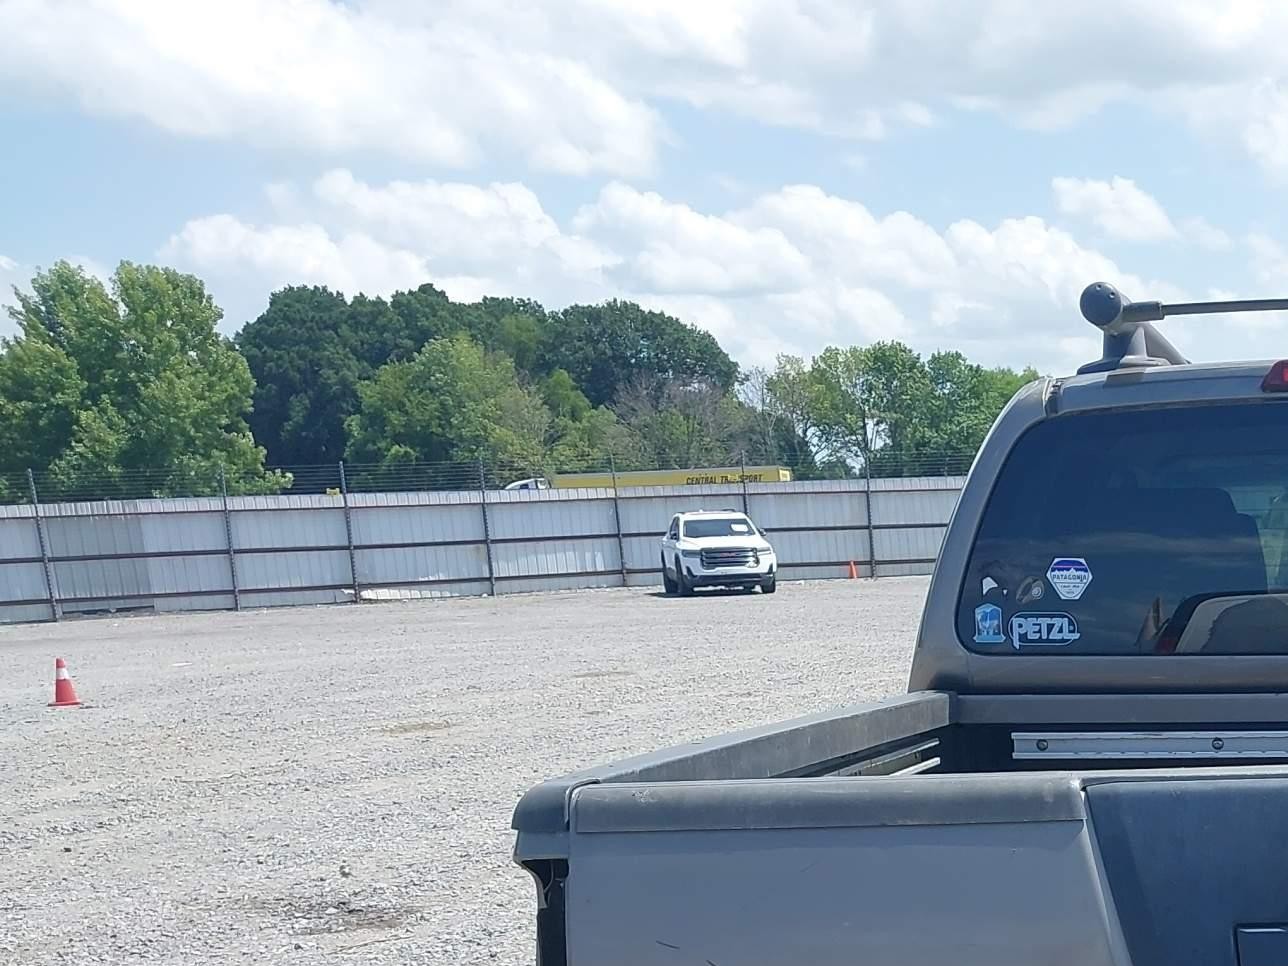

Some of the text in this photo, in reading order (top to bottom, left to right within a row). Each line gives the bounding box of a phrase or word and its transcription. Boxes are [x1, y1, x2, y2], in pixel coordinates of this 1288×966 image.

[686, 476, 717, 485] CENTRAL
[1052, 573, 1087, 582] PATAGONIA
[1012, 617, 1081, 649] PETZL
